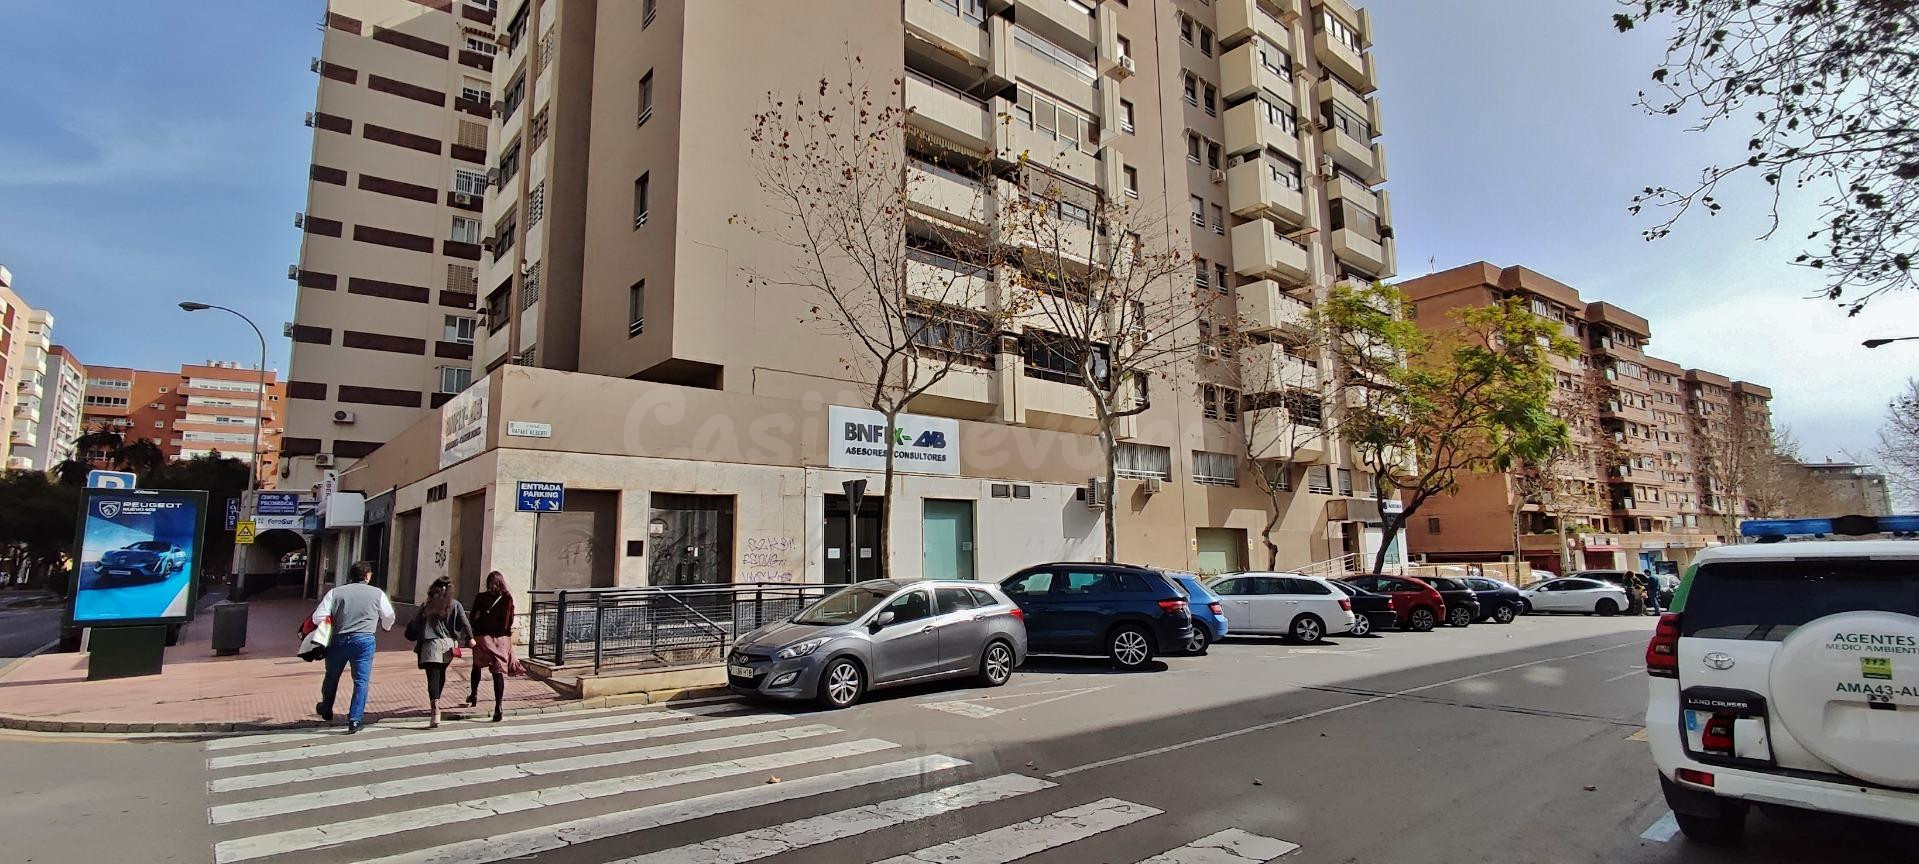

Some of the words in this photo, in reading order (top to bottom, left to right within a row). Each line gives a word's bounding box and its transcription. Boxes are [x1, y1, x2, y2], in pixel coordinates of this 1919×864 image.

[845, 447, 887, 457] ASESORES
[894, 450, 946, 461] CONSULTORES
[521, 483, 561, 491] ENTRADA
[523, 490, 559, 498] PARKING
[123, 501, 183, 509] PEUGEOT
[1833, 633, 1916, 646] AGENTES
[1825, 643, 1861, 651] MEDIO
[1865, 645, 1919, 654] AMBIENT
[1688, 698, 1711, 706] LAND
[1711, 700, 1748, 708] CRUISER
